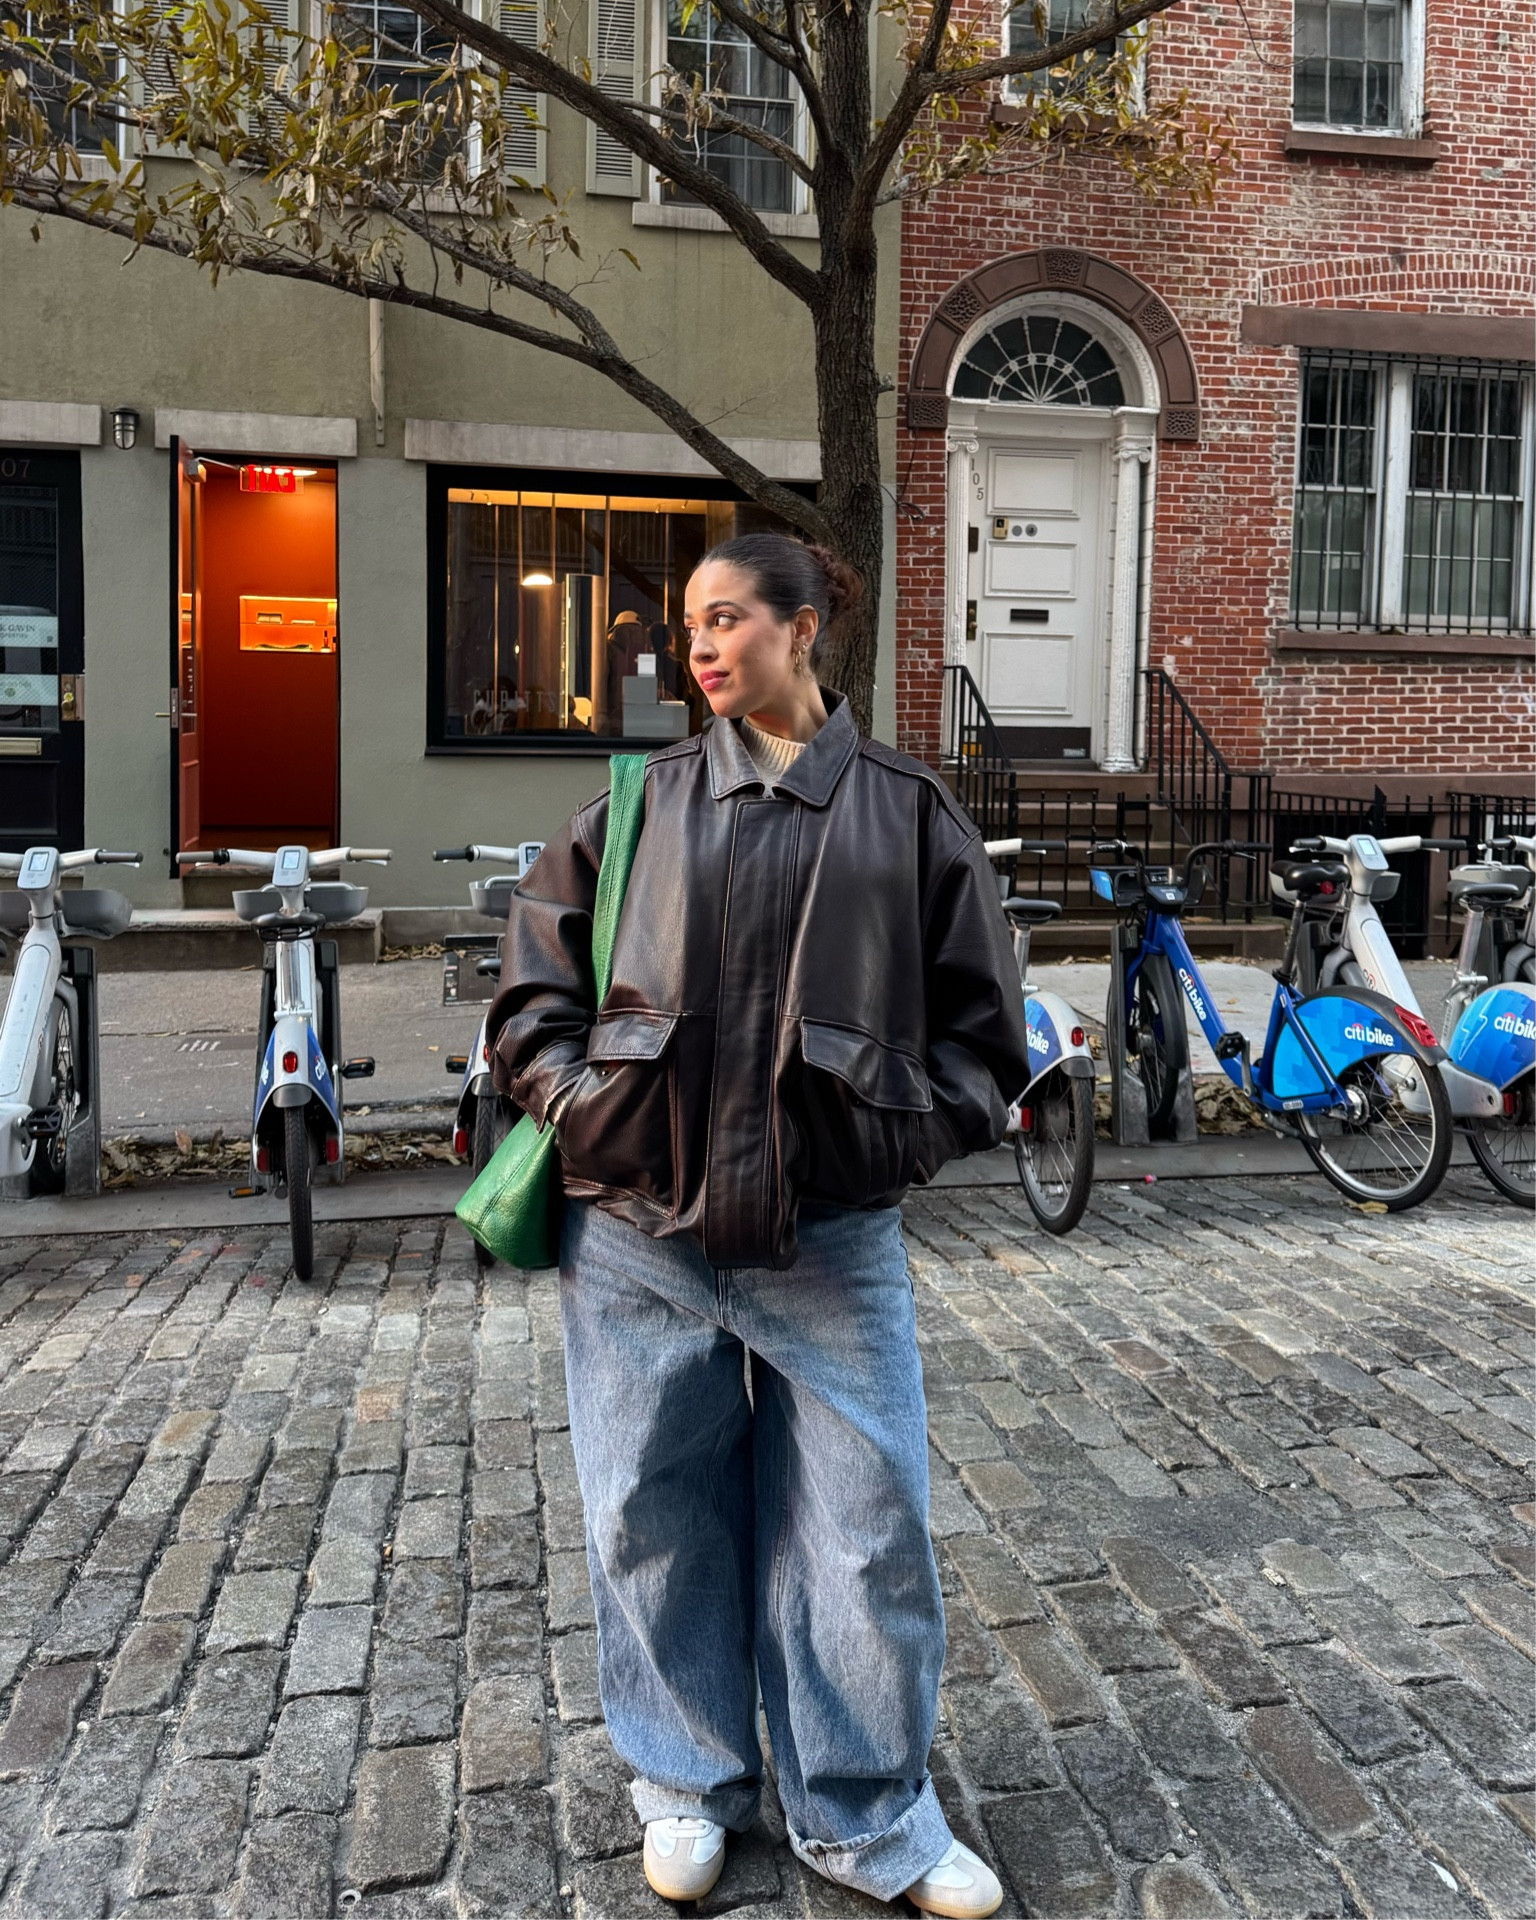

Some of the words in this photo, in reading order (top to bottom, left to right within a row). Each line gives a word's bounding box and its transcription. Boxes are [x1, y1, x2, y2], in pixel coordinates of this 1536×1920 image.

[473, 690, 557, 713] CUBITTS
[1179, 968, 1195, 991] citi
[1189, 988, 1207, 1021] bike
[1344, 1022, 1365, 1042] citi
[1366, 1026, 1395, 1047] bike
[1494, 1012, 1515, 1034] citi
[1513, 1017, 1536, 1040] bik
